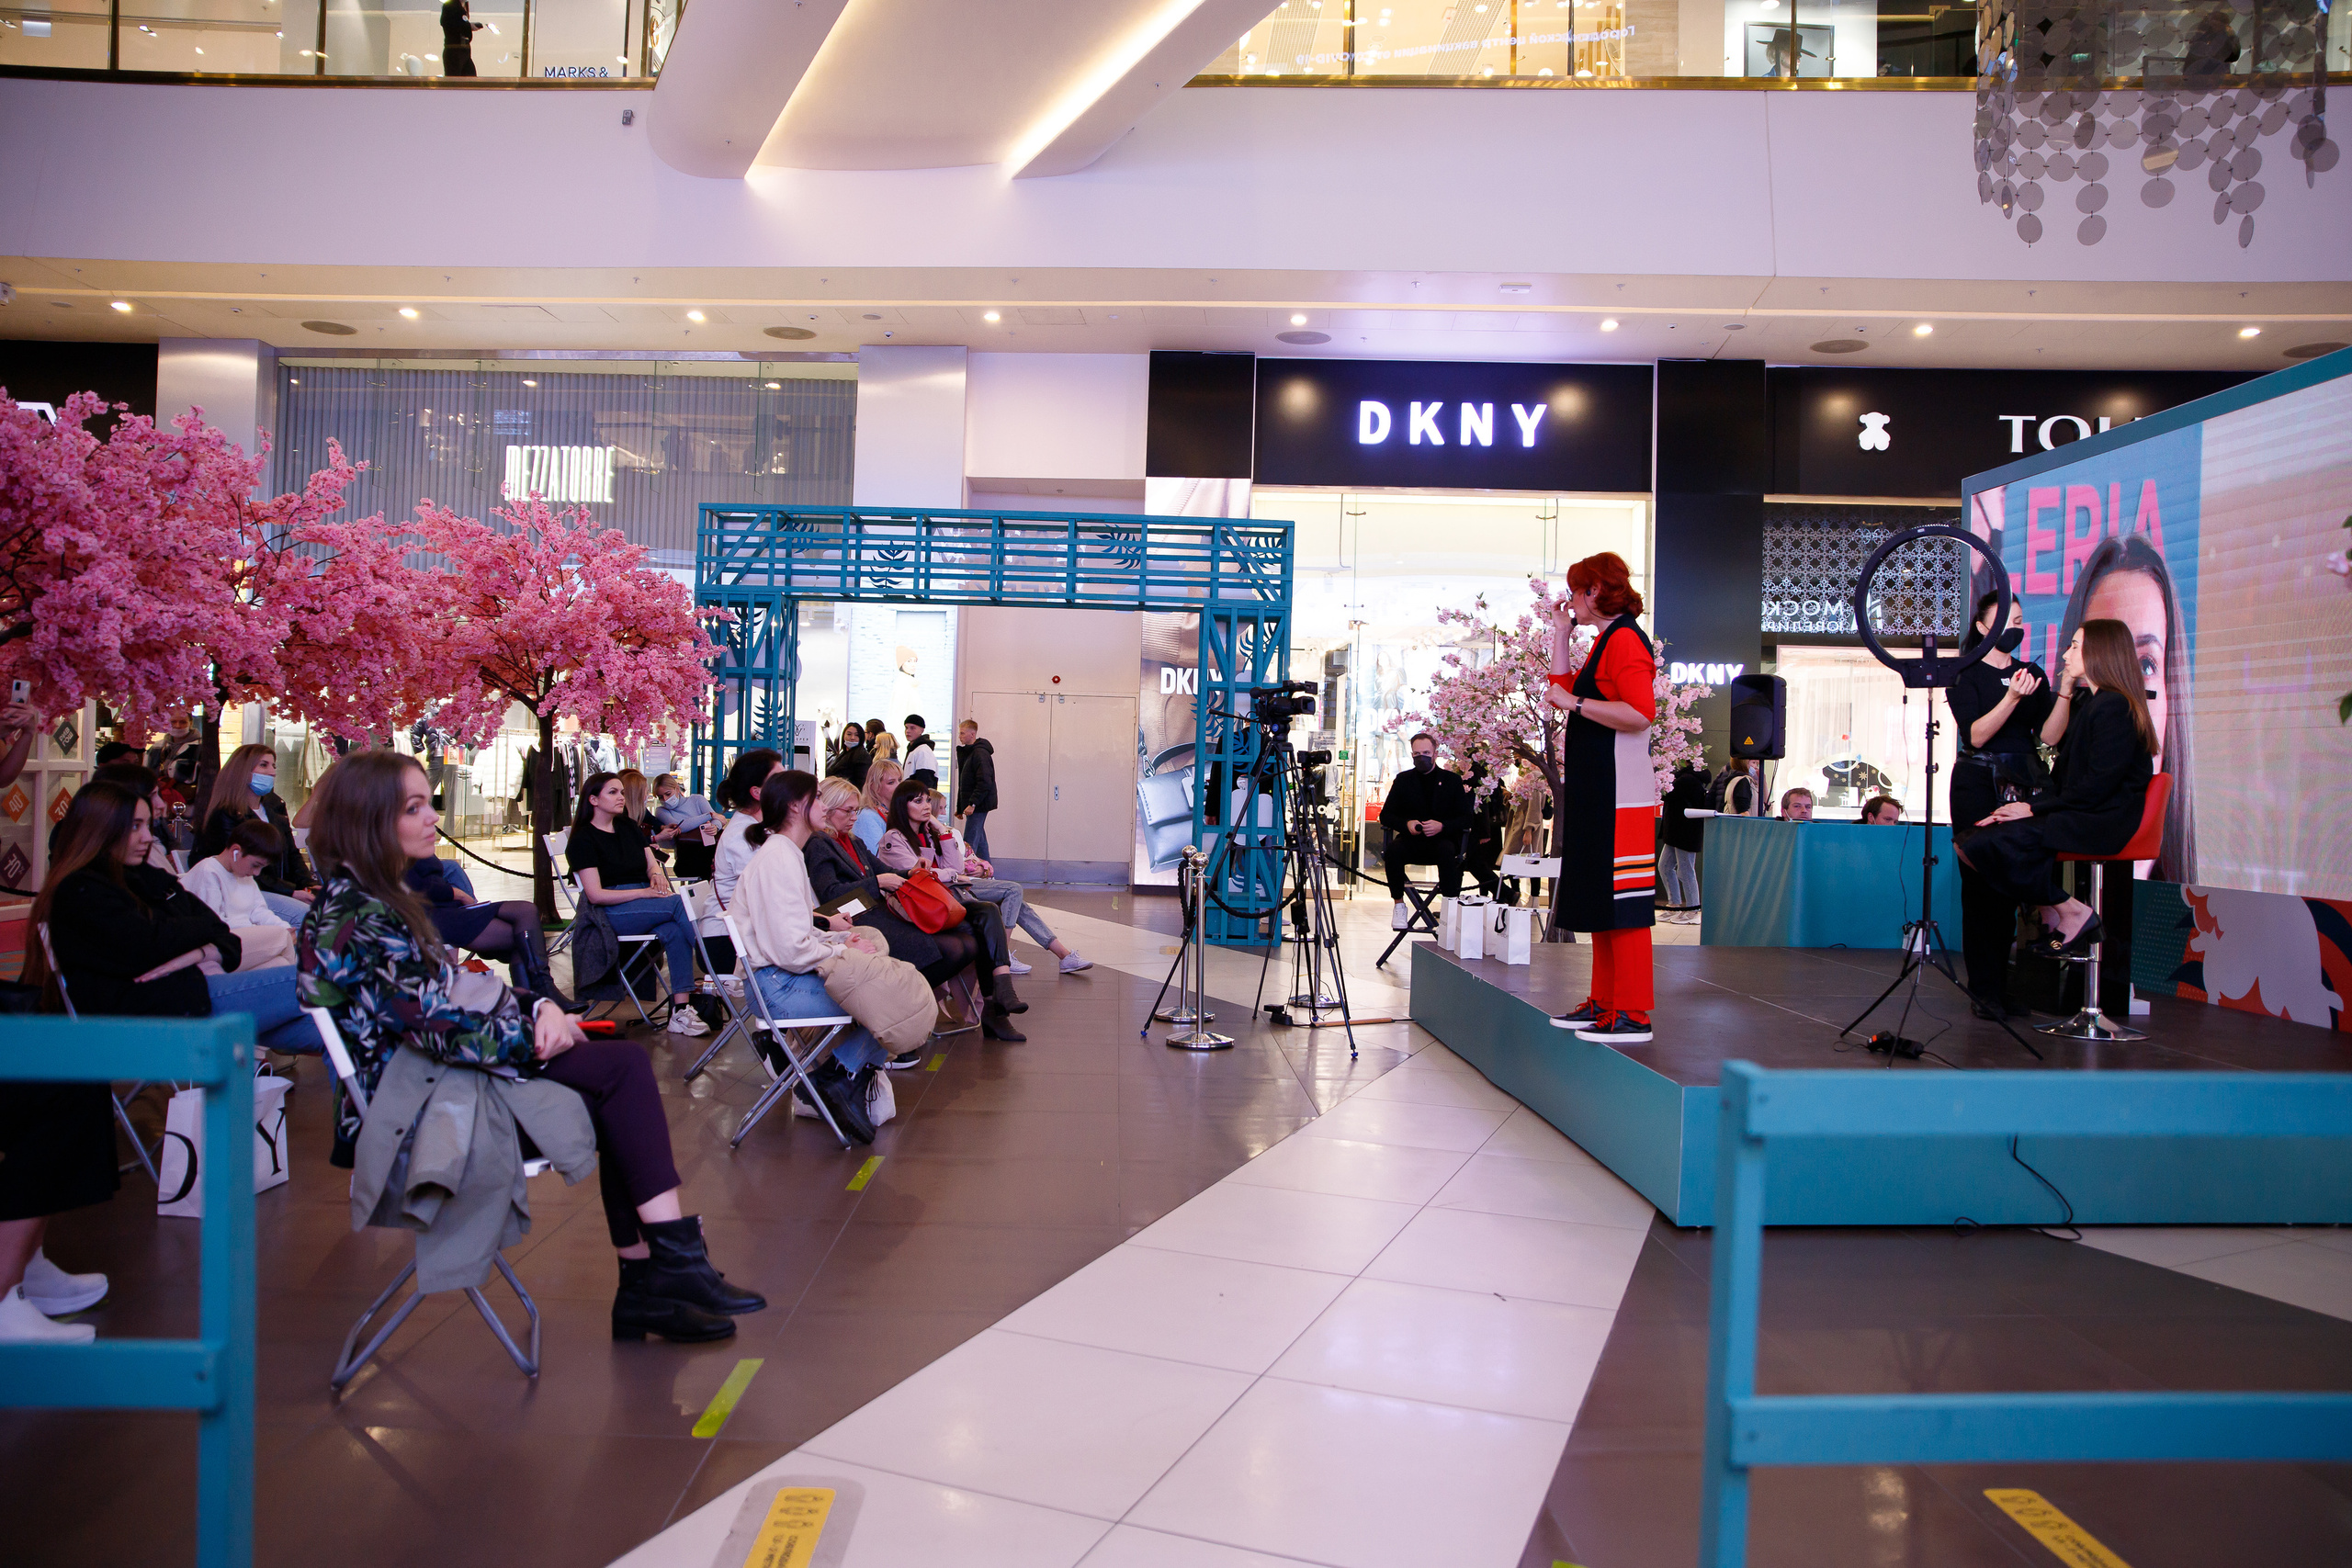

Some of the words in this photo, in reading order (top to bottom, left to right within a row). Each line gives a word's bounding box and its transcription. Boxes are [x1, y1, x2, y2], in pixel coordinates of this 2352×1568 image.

[545, 66, 595, 77] MARKS
[599, 66, 608, 77] &
[1359, 400, 1547, 447] DKNY
[504, 446, 615, 502] MEZZATORRE
[1670, 662, 1744, 685] DKNY
